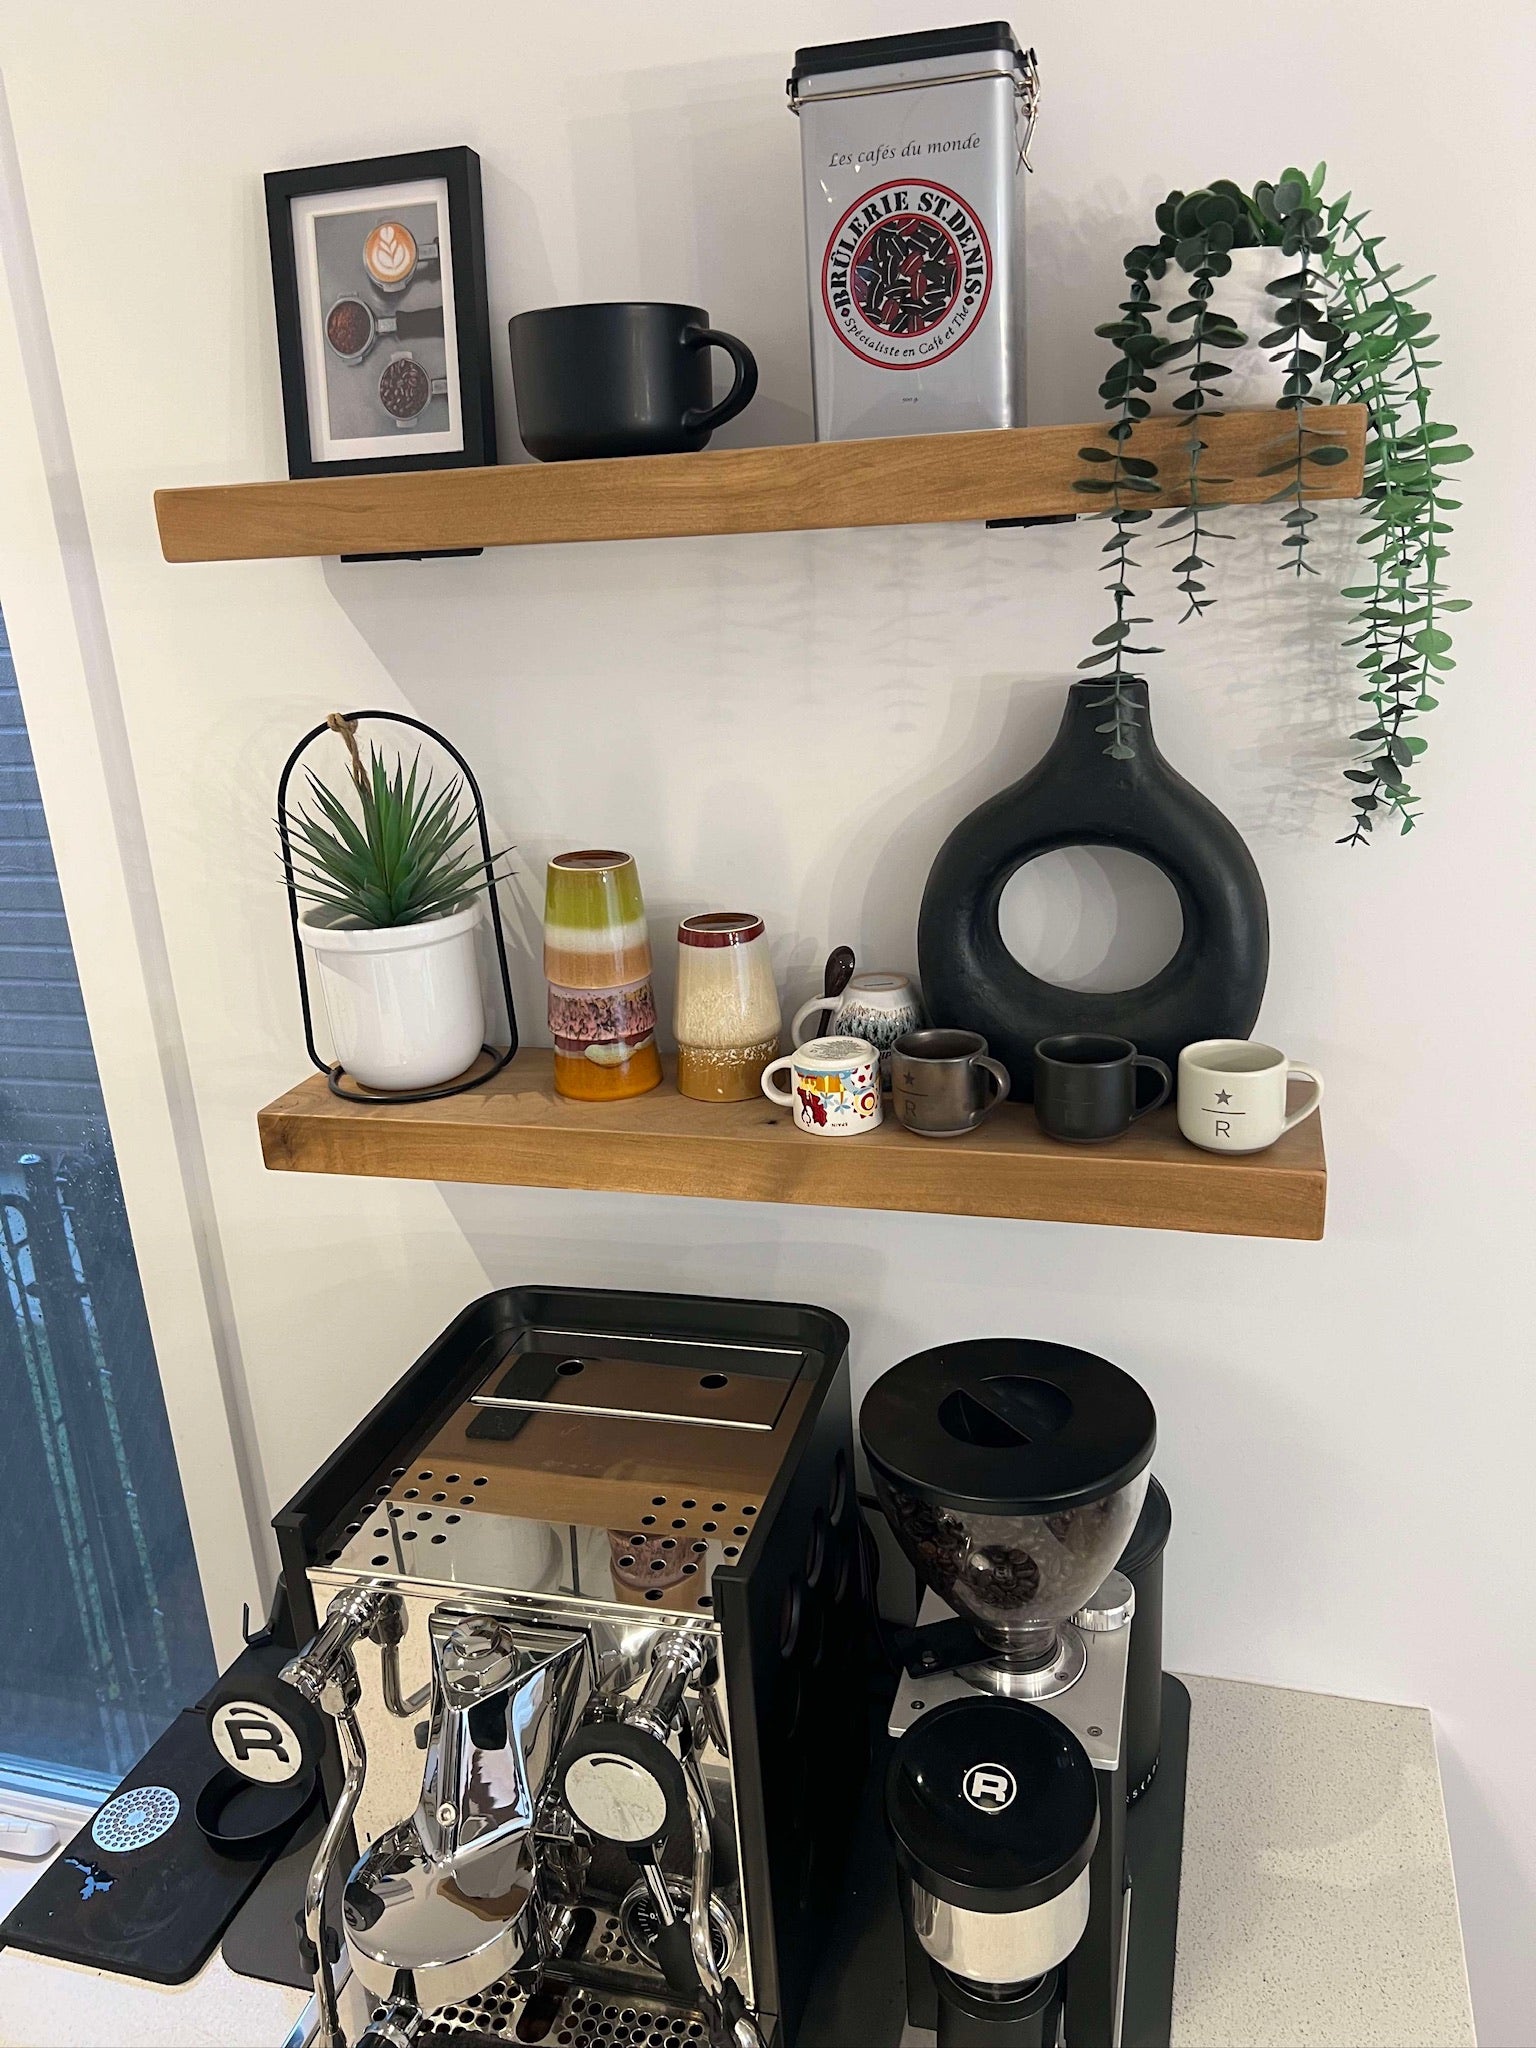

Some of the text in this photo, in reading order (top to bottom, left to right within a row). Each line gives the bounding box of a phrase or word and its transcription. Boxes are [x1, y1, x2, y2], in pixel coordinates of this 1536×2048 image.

[828, 132, 981, 168] Les cafés du monde
[830, 190, 909, 310] BRÛLERIE
[843, 317, 900, 358] Spécialiste
[902, 347, 916, 358] en
[918, 335, 944, 355] Café
[945, 326, 955, 340] et
[904, 1100, 917, 1118] R
[1215, 1119, 1231, 1138] R
[224, 1719, 290, 1764] R
[971, 1771, 1009, 1803] R
